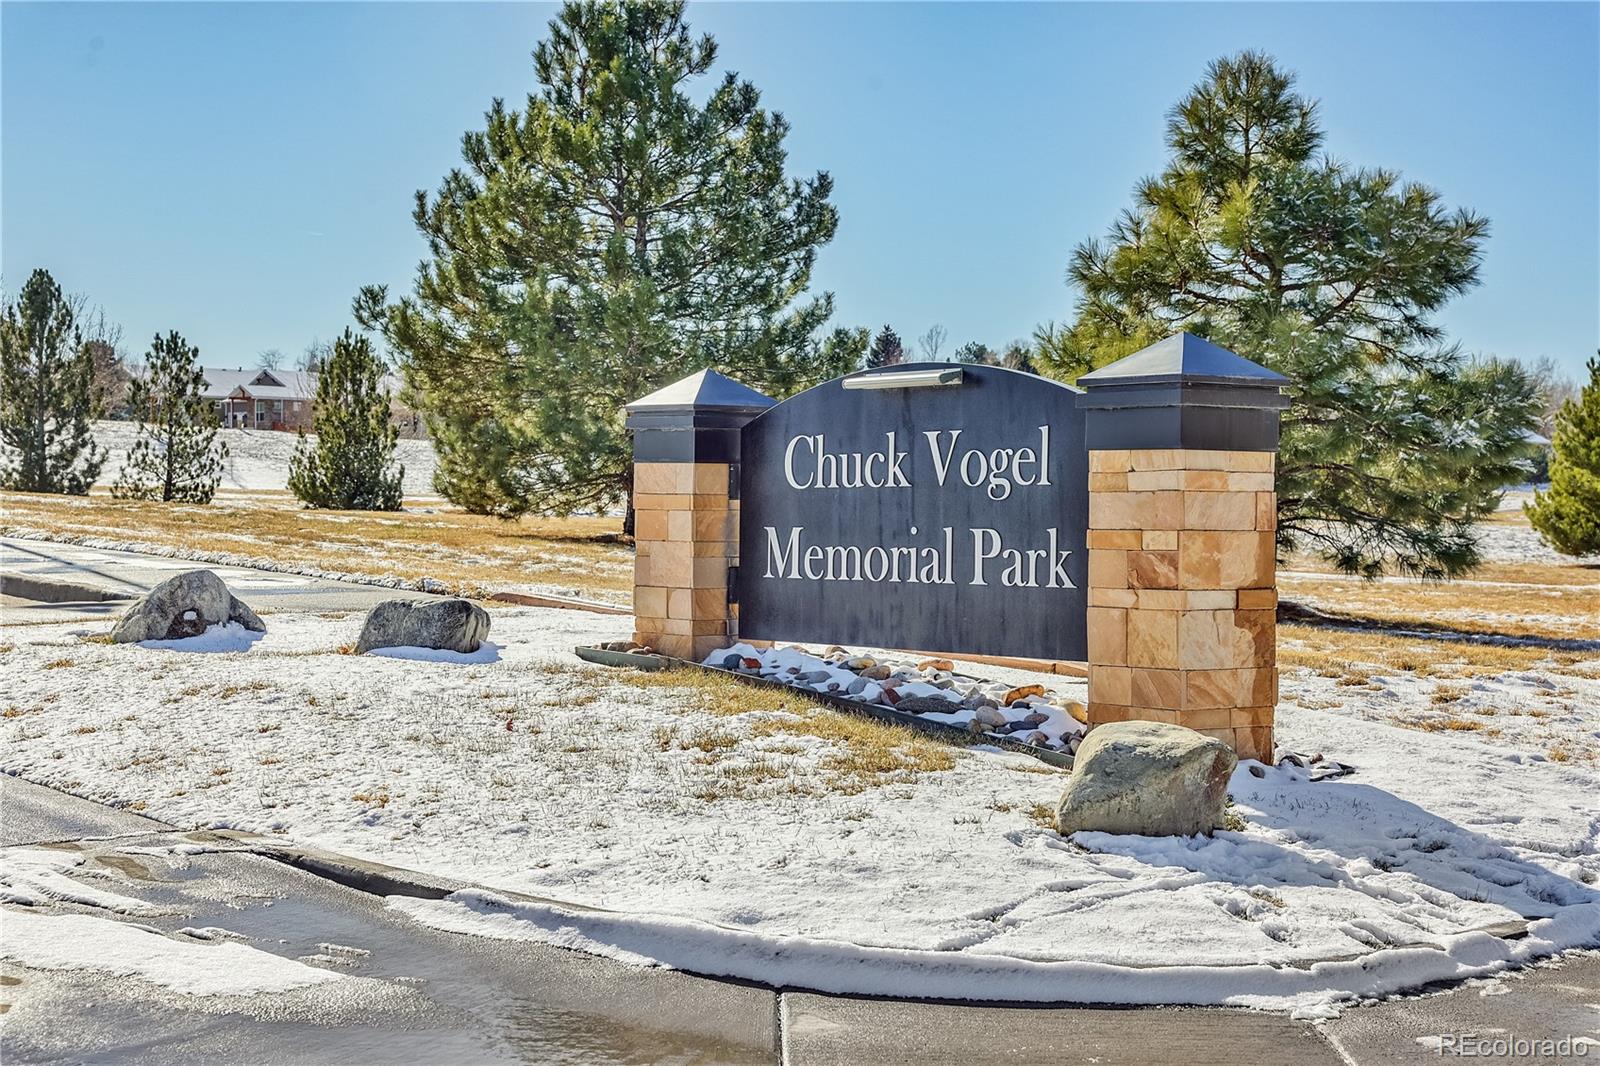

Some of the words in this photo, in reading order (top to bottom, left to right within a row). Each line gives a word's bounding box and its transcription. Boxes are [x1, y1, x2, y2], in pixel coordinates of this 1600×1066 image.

[784, 431, 912, 490] Chuck
[922, 425, 1052, 501] Vogel
[762, 526, 956, 585] Memorial
[968, 527, 1078, 589] Park
